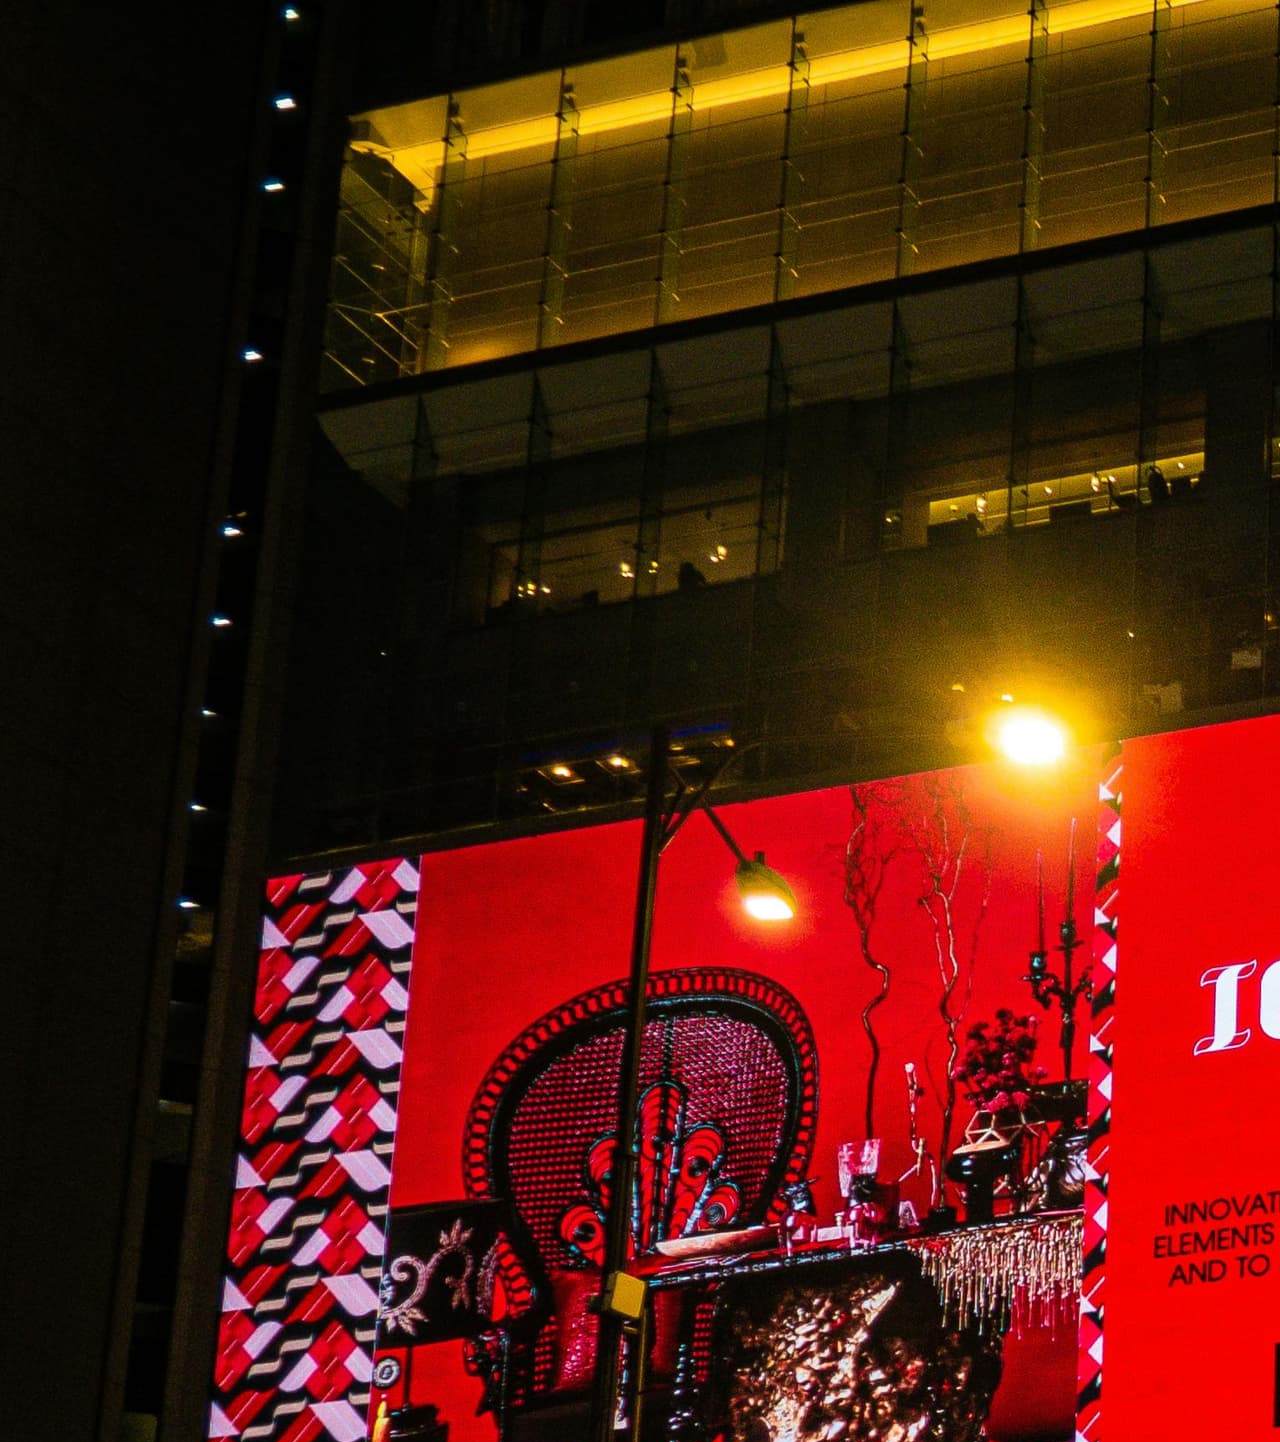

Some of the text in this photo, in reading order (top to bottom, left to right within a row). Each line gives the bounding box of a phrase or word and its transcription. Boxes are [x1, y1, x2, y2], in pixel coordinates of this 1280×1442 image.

[1152, 1223, 1276, 1259] ELEMENTS
[1168, 1256, 1227, 1288] AND
[1236, 1252, 1272, 1280] TO
